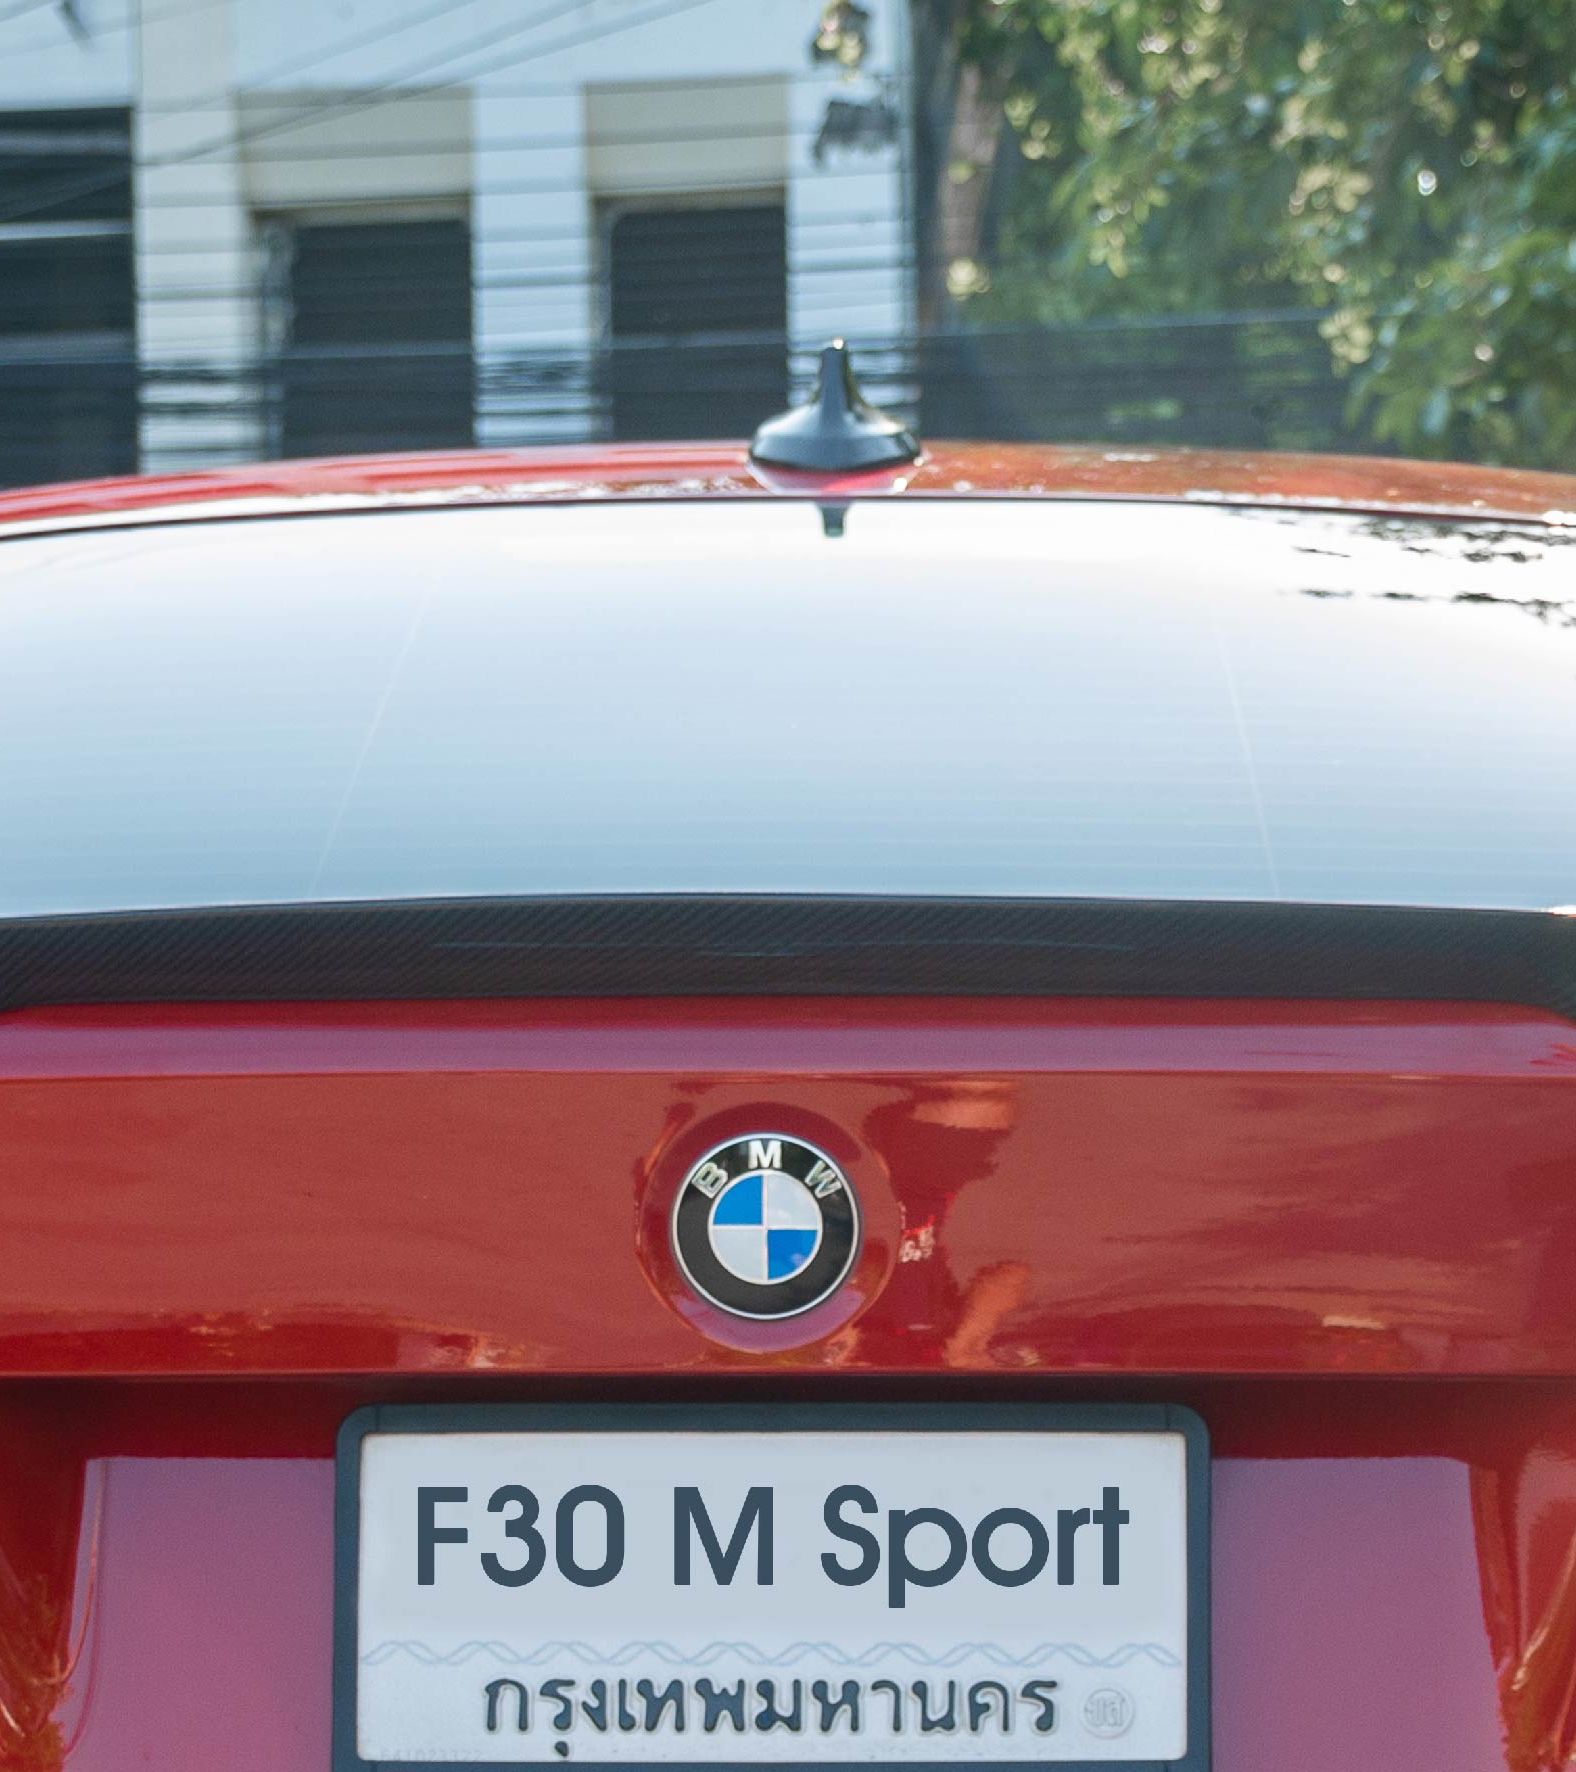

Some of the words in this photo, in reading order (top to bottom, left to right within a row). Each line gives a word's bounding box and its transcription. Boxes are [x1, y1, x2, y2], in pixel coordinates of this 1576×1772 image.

[691, 1140, 842, 1199] BMW
[485, 1679, 1057, 1757] กรุงเทพมหานคร
